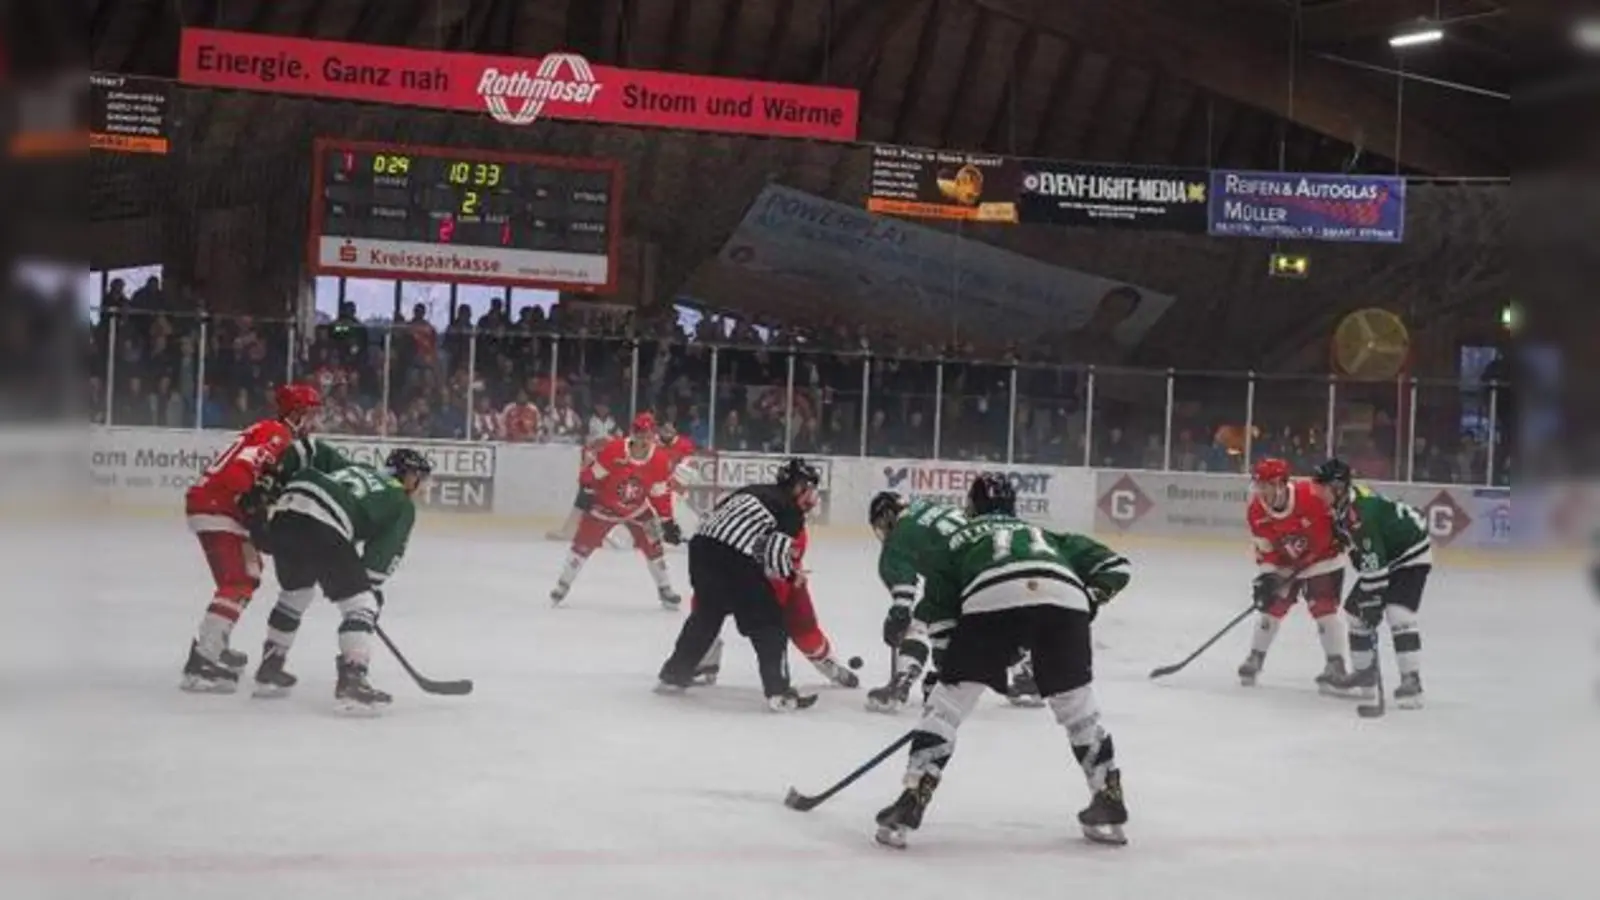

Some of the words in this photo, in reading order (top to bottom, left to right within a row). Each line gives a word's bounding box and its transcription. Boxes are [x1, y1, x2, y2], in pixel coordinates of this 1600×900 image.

[196, 46, 311, 84] Energie.
[322, 56, 391, 86] Ganz
[401, 69, 449, 92] nah
[477, 67, 602, 104] Rothmoser
[622, 83, 697, 113] Strom
[706, 92, 753, 118] und
[1039, 171, 1188, 204] EVENT-LIGHT-MEDIA
[1294, 178, 1378, 200] AUTOGLAS
[370, 249, 501, 272] Kreissparkasse
[91, 452, 127, 467] am
[1111, 490, 1136, 520] G
[1428, 505, 1453, 536] G
